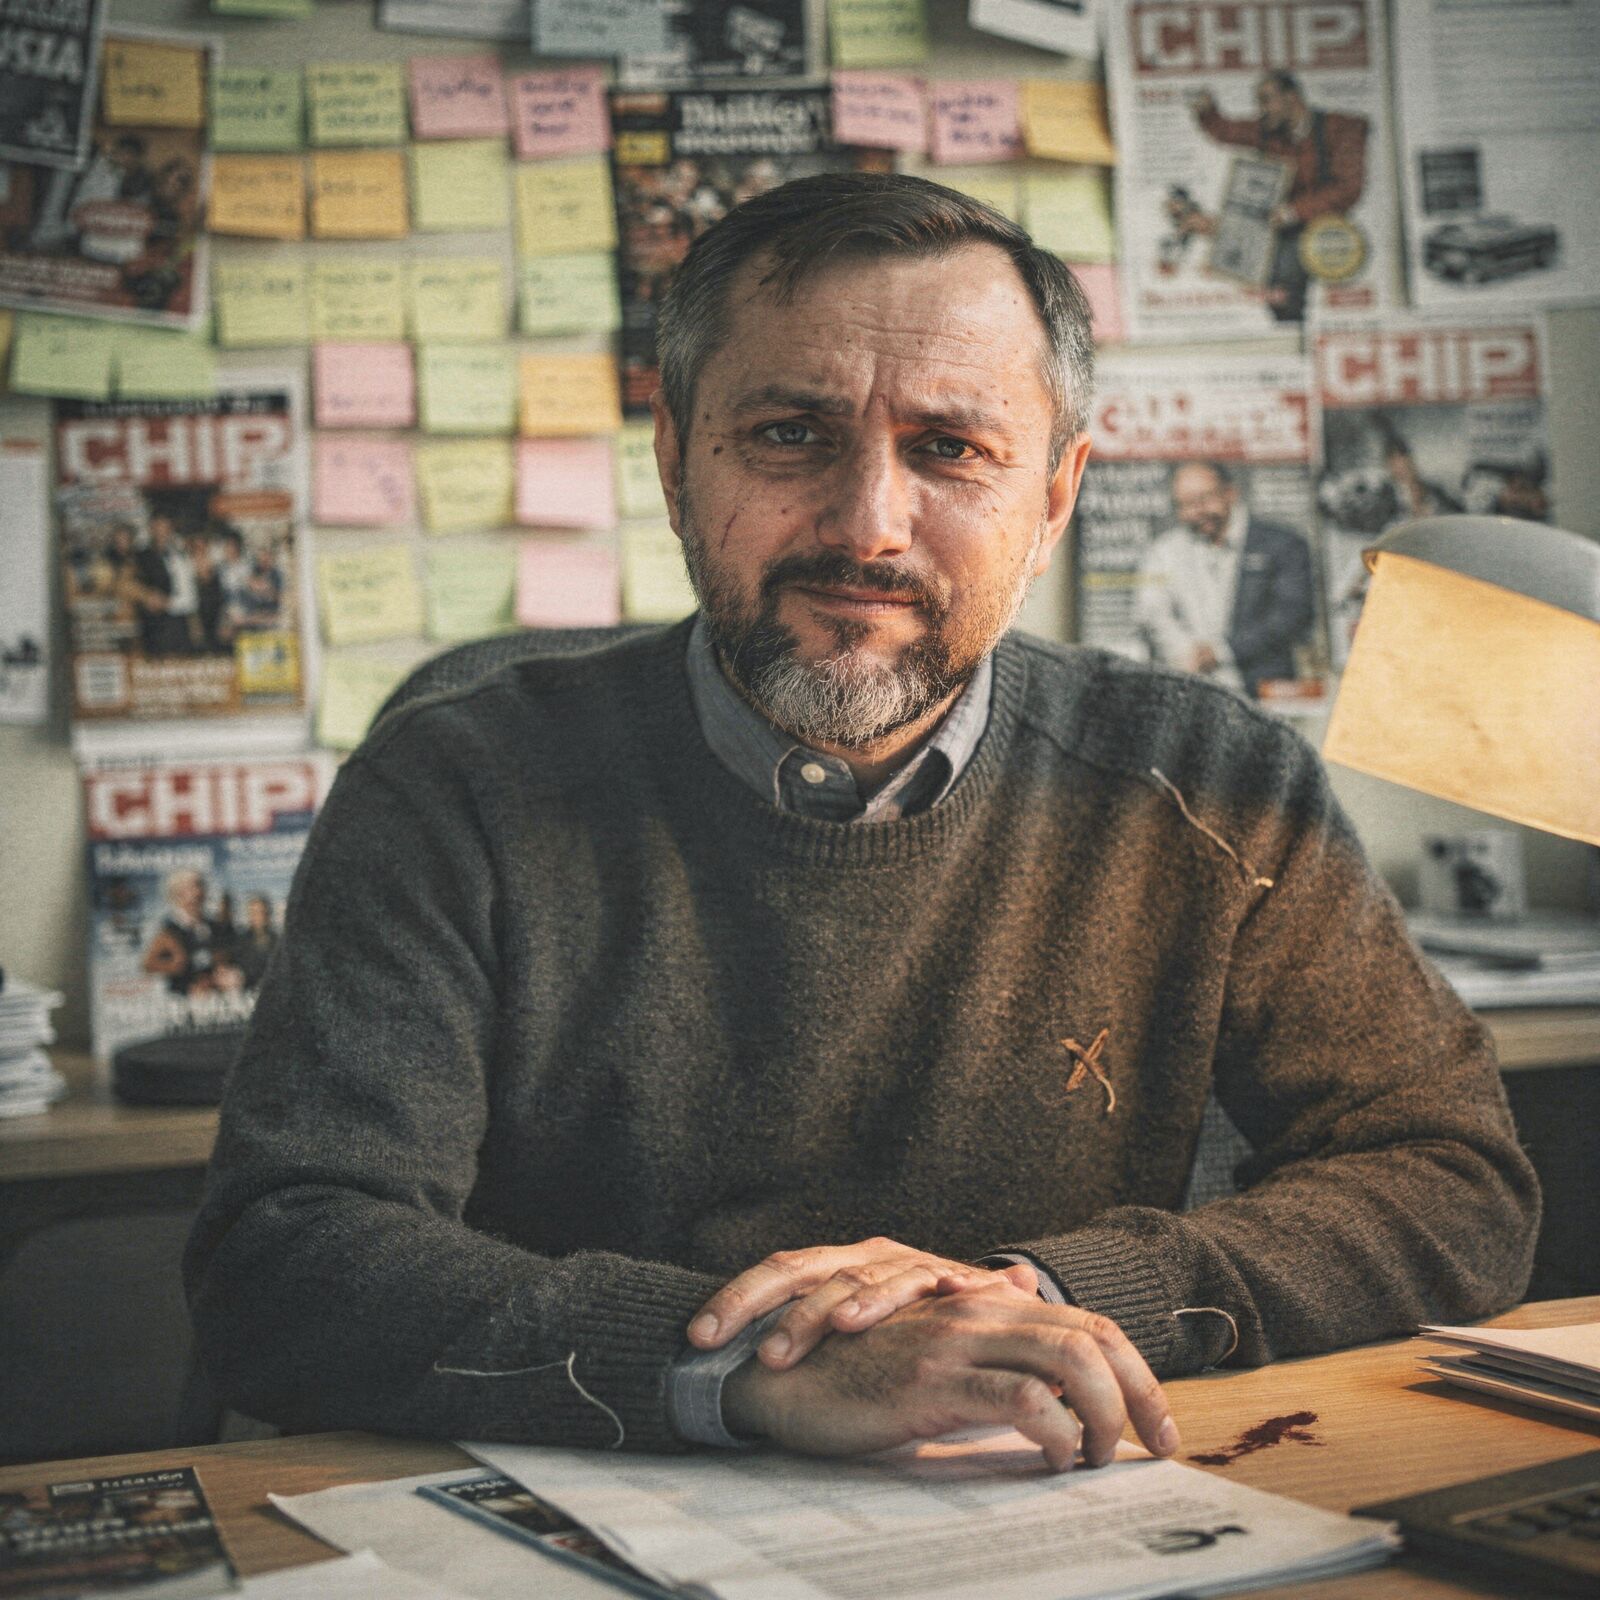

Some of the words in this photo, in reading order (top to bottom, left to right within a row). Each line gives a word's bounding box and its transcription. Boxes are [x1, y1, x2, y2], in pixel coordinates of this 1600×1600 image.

[1138, 4, 1361, 67] CHIP
[1322, 336, 1529, 400] CHIP
[61, 414, 288, 482] CHIP
[92, 766, 308, 838] CHIP
